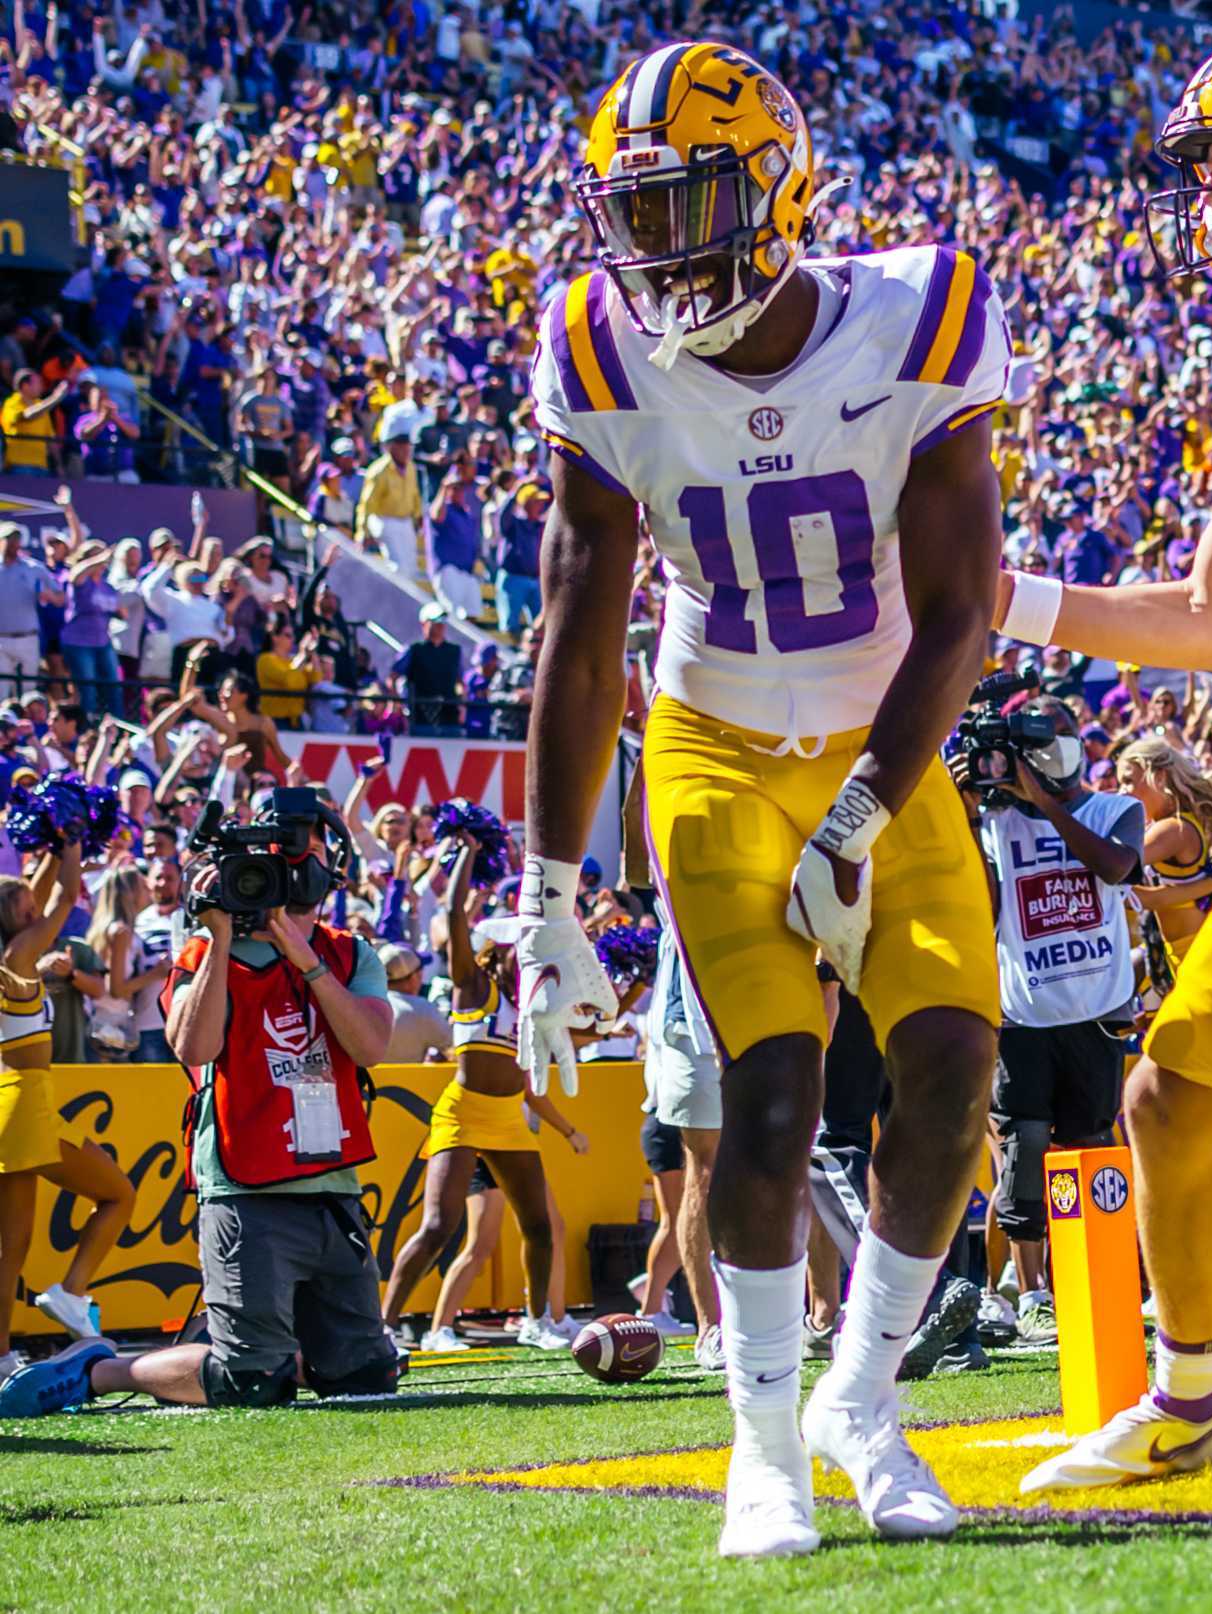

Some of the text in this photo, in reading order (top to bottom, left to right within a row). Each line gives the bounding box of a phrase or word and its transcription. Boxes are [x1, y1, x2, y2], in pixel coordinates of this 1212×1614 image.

[751, 407, 783, 440] SEC
[738, 454, 794, 476] LSU
[677, 468, 880, 655] 10
[1010, 837, 1080, 869] LS
[1044, 877, 1090, 895] FARM
[1024, 935, 1113, 972] MEDIA
[1092, 1167, 1127, 1211] SEC
